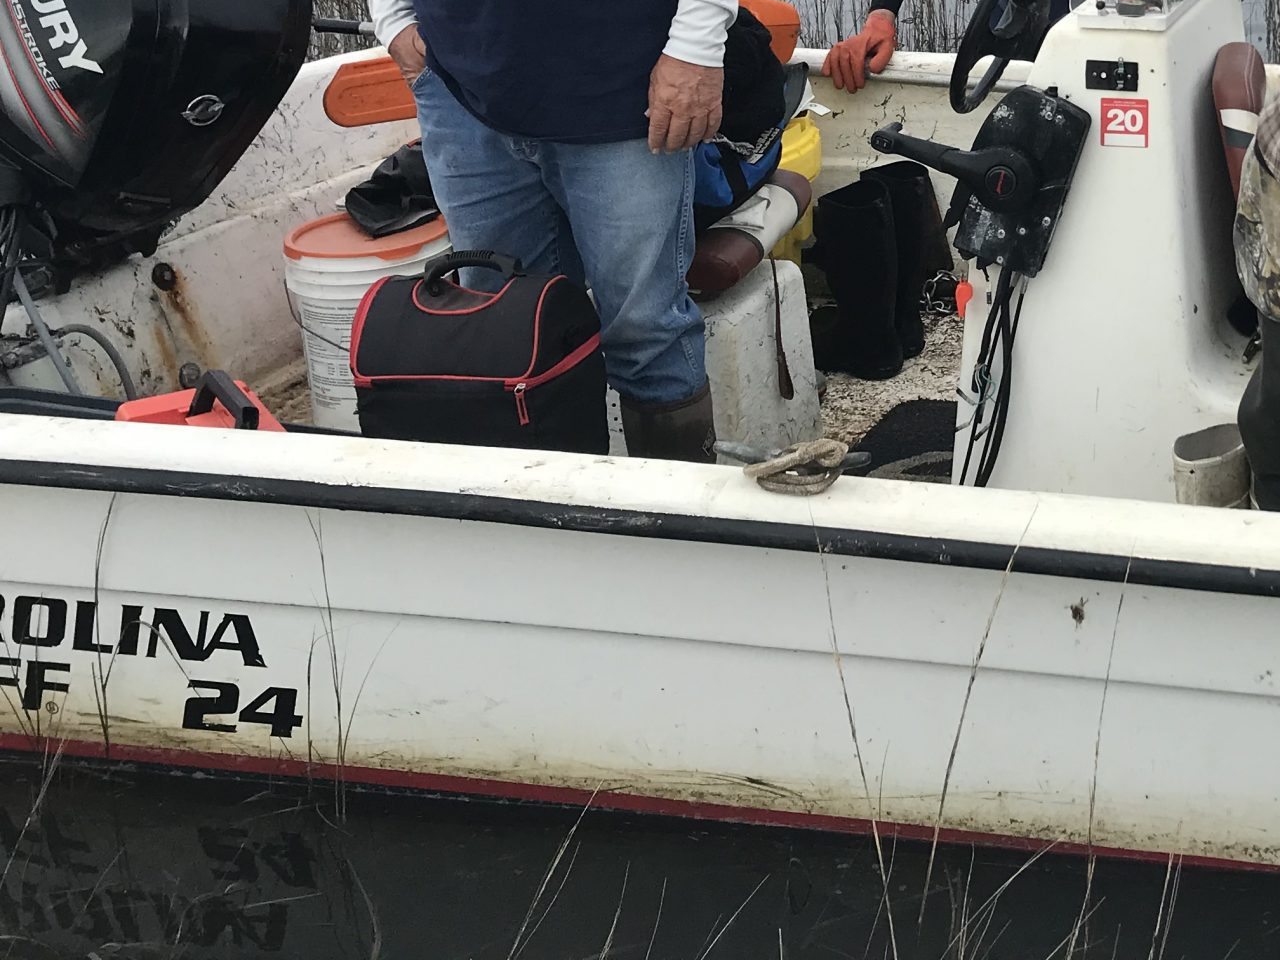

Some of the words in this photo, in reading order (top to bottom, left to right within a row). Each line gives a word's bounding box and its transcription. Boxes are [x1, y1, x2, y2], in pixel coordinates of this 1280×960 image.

[1106, 108, 1144, 133] 20
[0, 593, 267, 668] OLINA
[182, 679, 304, 738] 24
